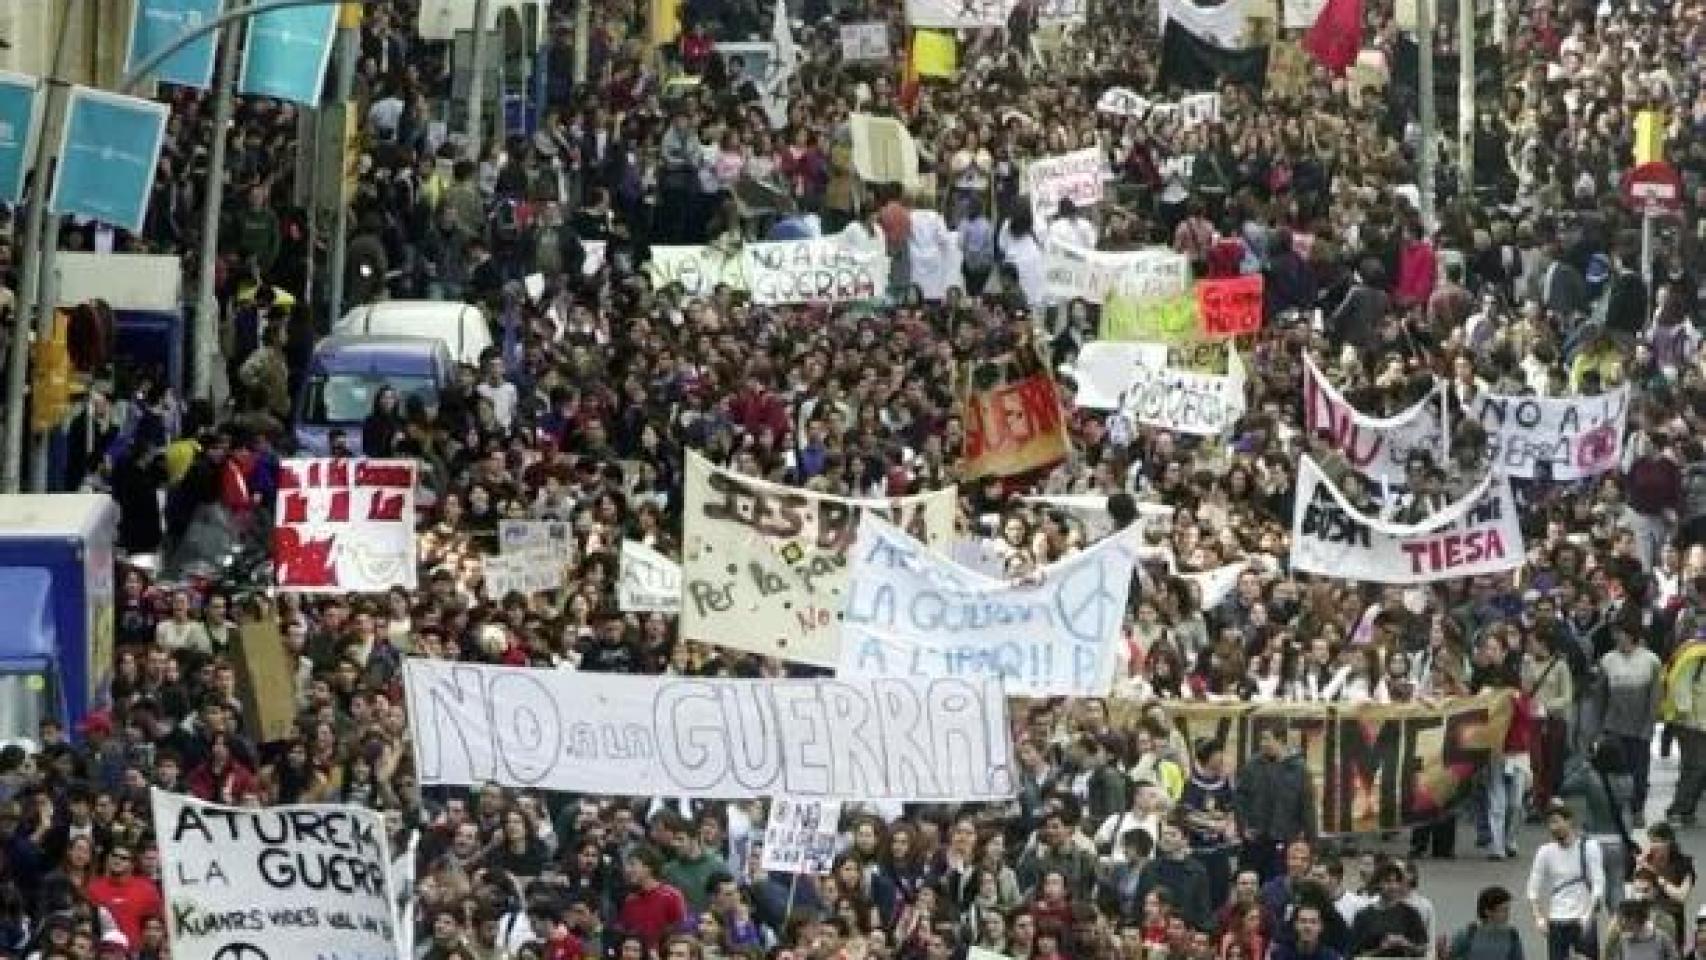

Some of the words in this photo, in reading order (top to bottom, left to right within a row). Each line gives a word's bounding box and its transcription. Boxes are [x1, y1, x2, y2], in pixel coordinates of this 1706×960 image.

[757, 271, 875, 297] GUERRA
[1480, 397, 1542, 428] NO
[1401, 528, 1505, 574] TIESA
[690, 580, 735, 617] Per
[748, 560, 790, 597] la
[407, 662, 563, 785] NO
[652, 677, 1013, 797] GUERRA!
[178, 859, 229, 885] LA
